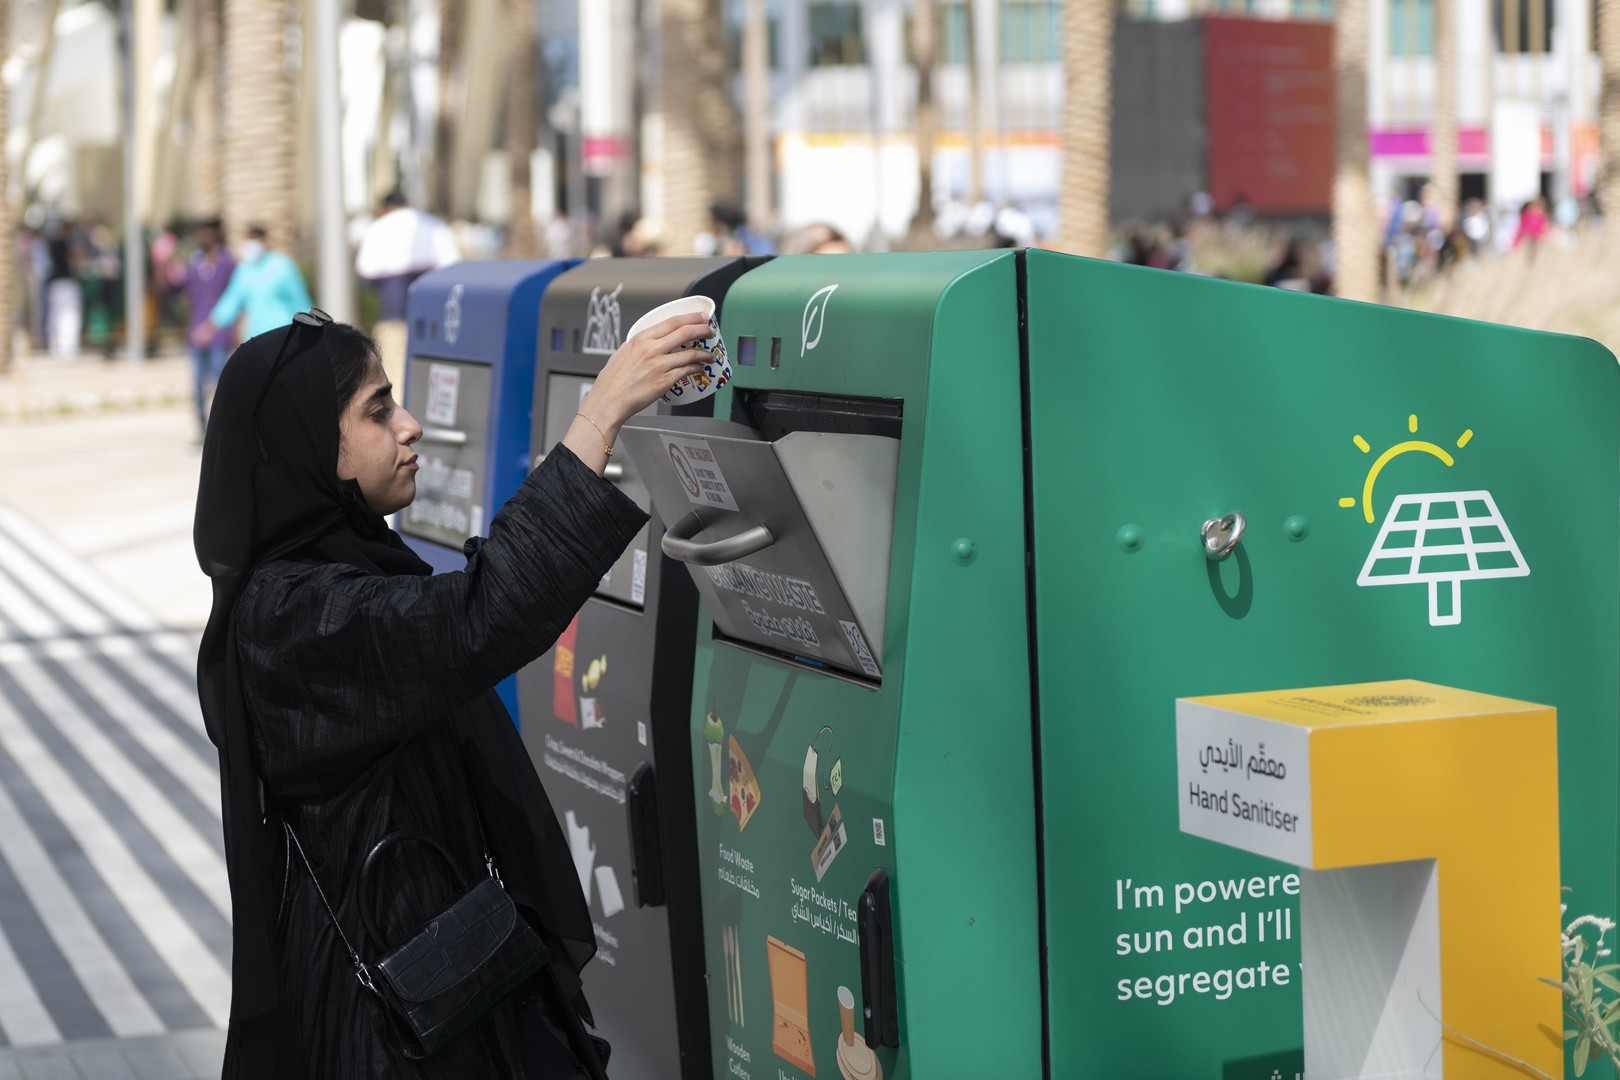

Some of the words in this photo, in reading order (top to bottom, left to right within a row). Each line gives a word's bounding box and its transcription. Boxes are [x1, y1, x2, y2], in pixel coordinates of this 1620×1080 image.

[704, 562, 772, 599] ORGANIC
[764, 571, 825, 615] WASTE
[1199, 737, 1243, 774] الأيدي
[1189, 781, 1229, 815] Hand
[1231, 792, 1299, 833] Sanitiser
[719, 842, 735, 864] Food
[733, 850, 754, 873] Waste
[735, 874, 760, 899] مخلفات
[790, 877, 811, 902] Sugar
[810, 886, 838, 914] Packets
[842, 901, 857, 922] Tea
[1174, 873, 1301, 914] powere
[1116, 928, 1174, 956] sun
[1182, 911, 1247, 950] and
[1116, 960, 1291, 1006] segregate
[725, 1034, 751, 1063] Wooden
